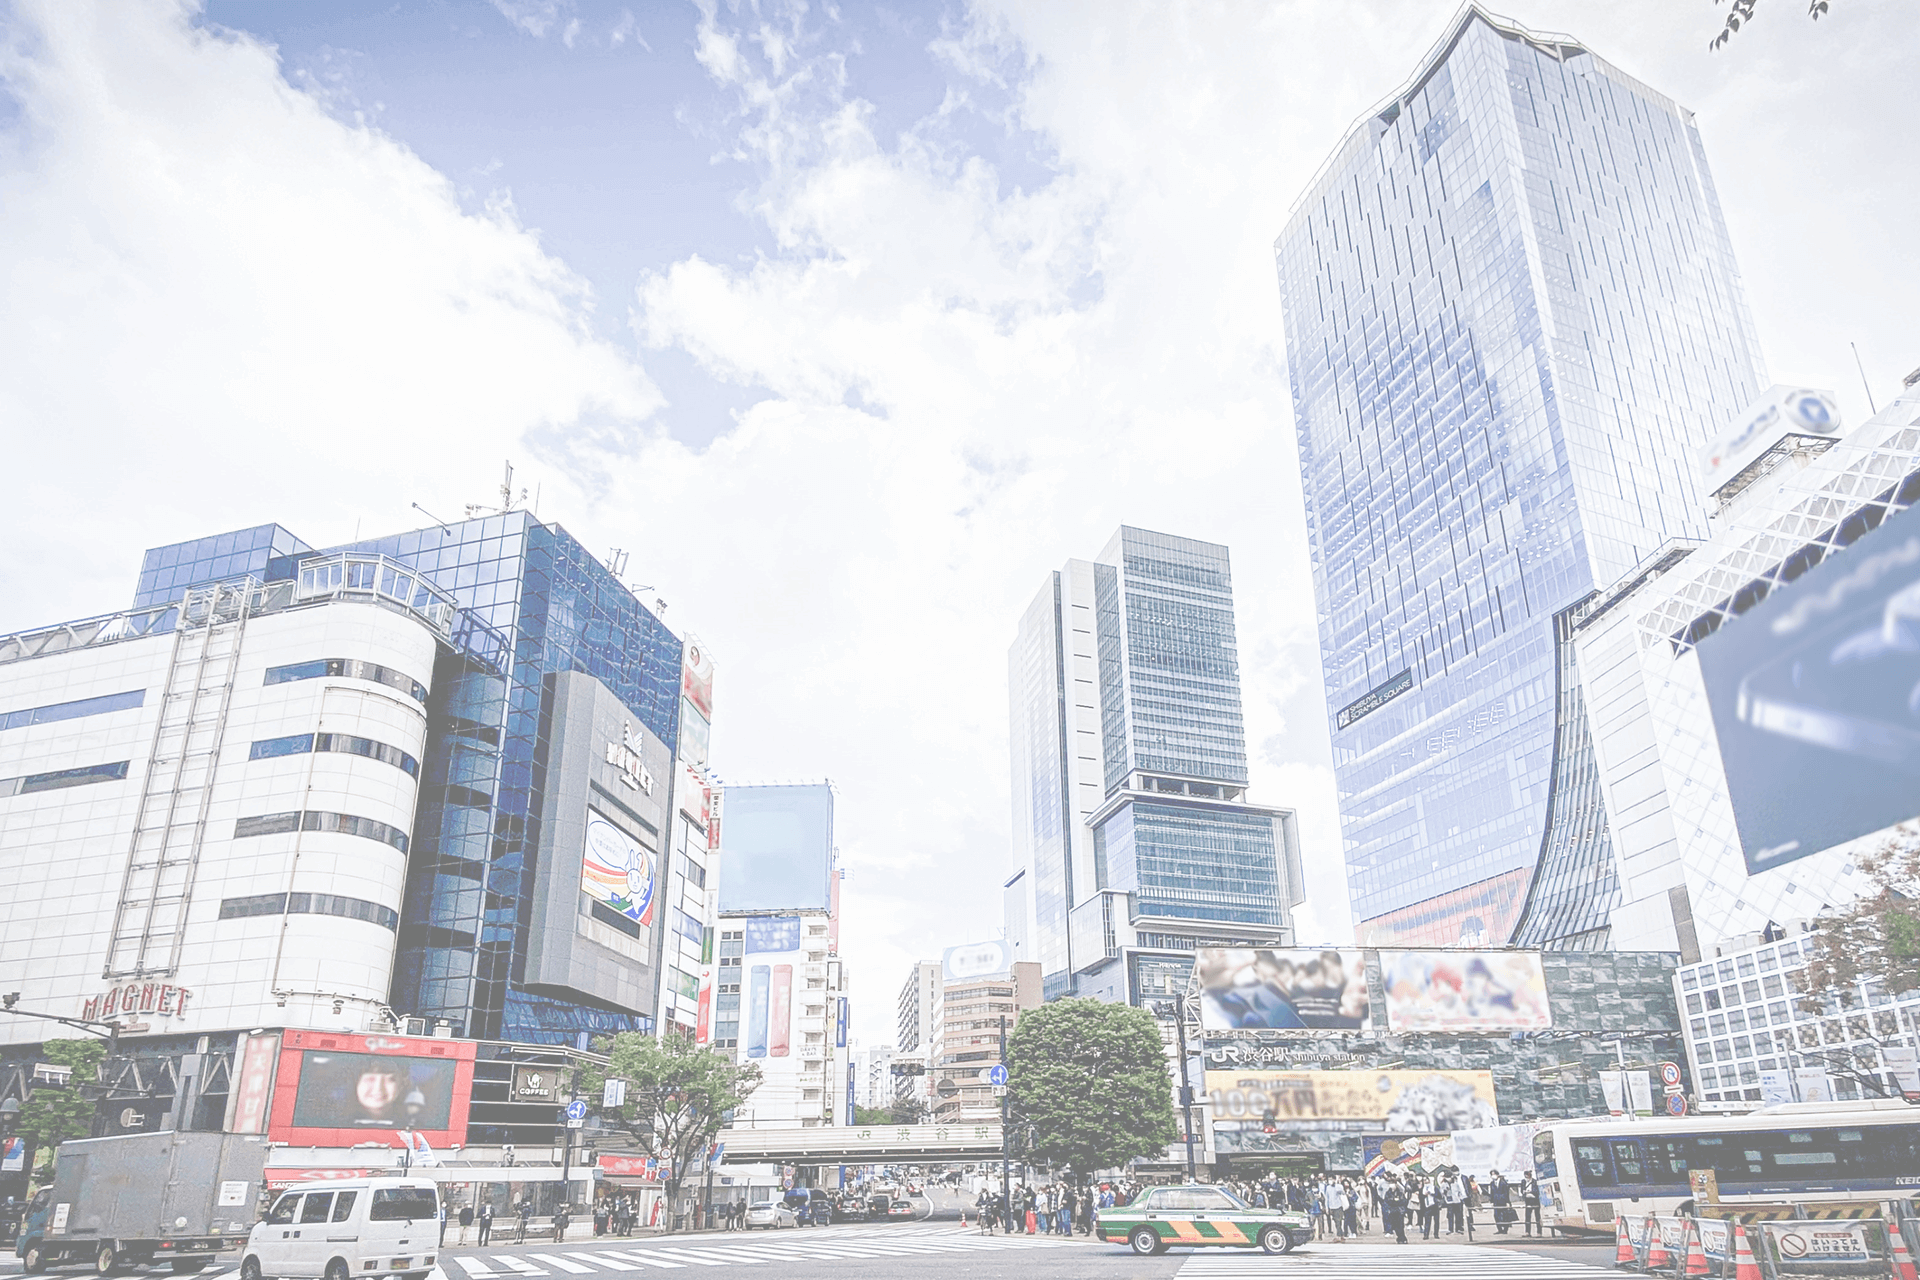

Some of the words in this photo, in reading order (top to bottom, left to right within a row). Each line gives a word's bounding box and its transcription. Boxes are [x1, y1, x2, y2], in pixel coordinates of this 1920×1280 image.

[1350, 695, 1383, 720] SCRAMBLE
[1384, 679, 1411, 701] SQUARE
[1350, 693, 1377, 713] SHIBUYA
[82, 984, 191, 1021] MAGNET
[1211, 1046, 1240, 1063] JR
[1243, 1047, 1291, 1062] 渋谷駅
[1292, 1053, 1331, 1062] shibuya
[1333, 1052, 1366, 1061] station
[520, 1088, 549, 1096] COFFEE
[857, 1130, 872, 1140] JR
[897, 1126, 989, 1141] 渋谷駅
